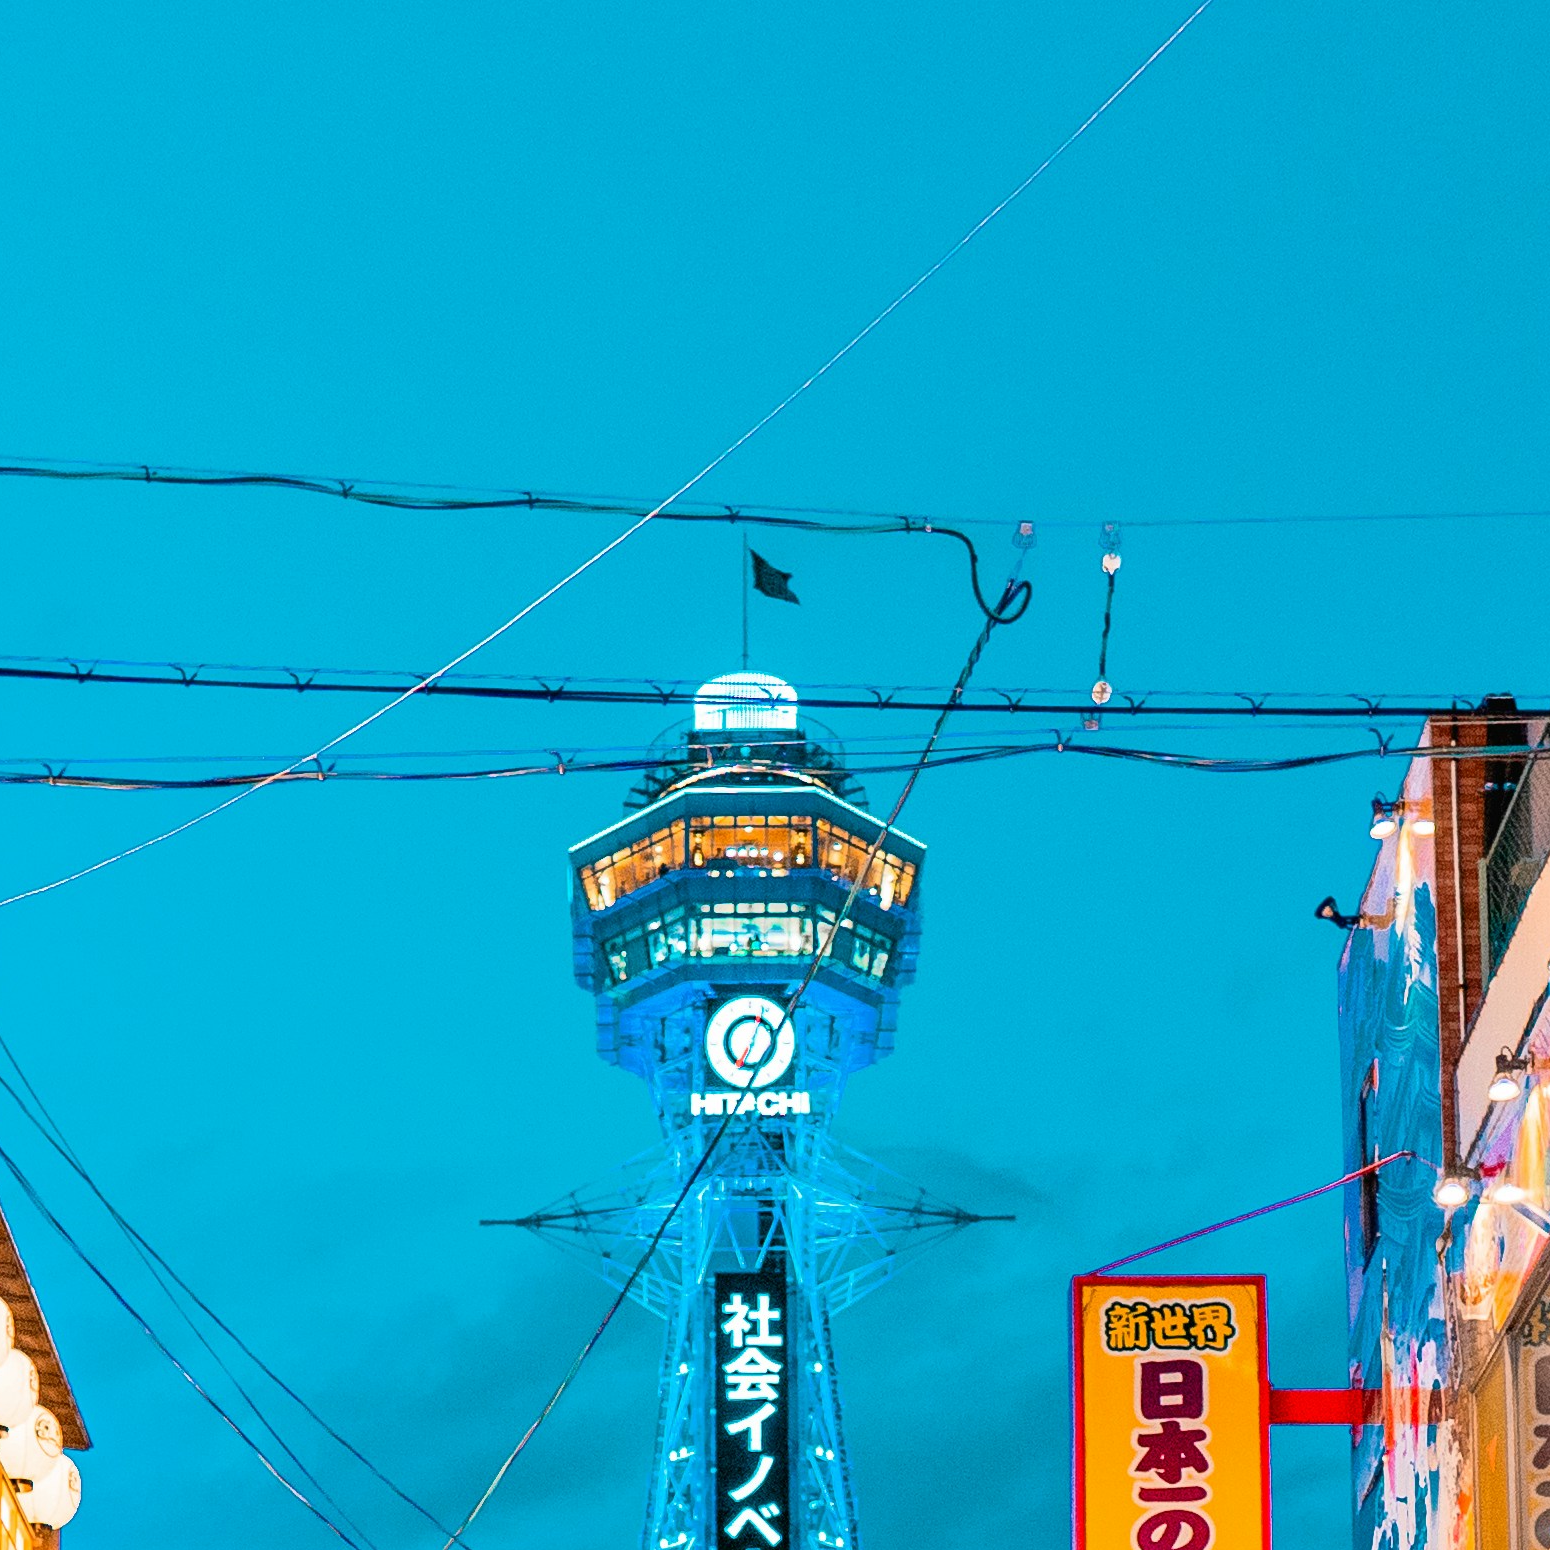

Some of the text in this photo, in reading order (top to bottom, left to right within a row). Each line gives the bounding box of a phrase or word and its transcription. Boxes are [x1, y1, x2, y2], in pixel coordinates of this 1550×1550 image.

[690, 1092, 810, 1117] HITACHI
[1106, 1302, 1234, 1352] 新世界
